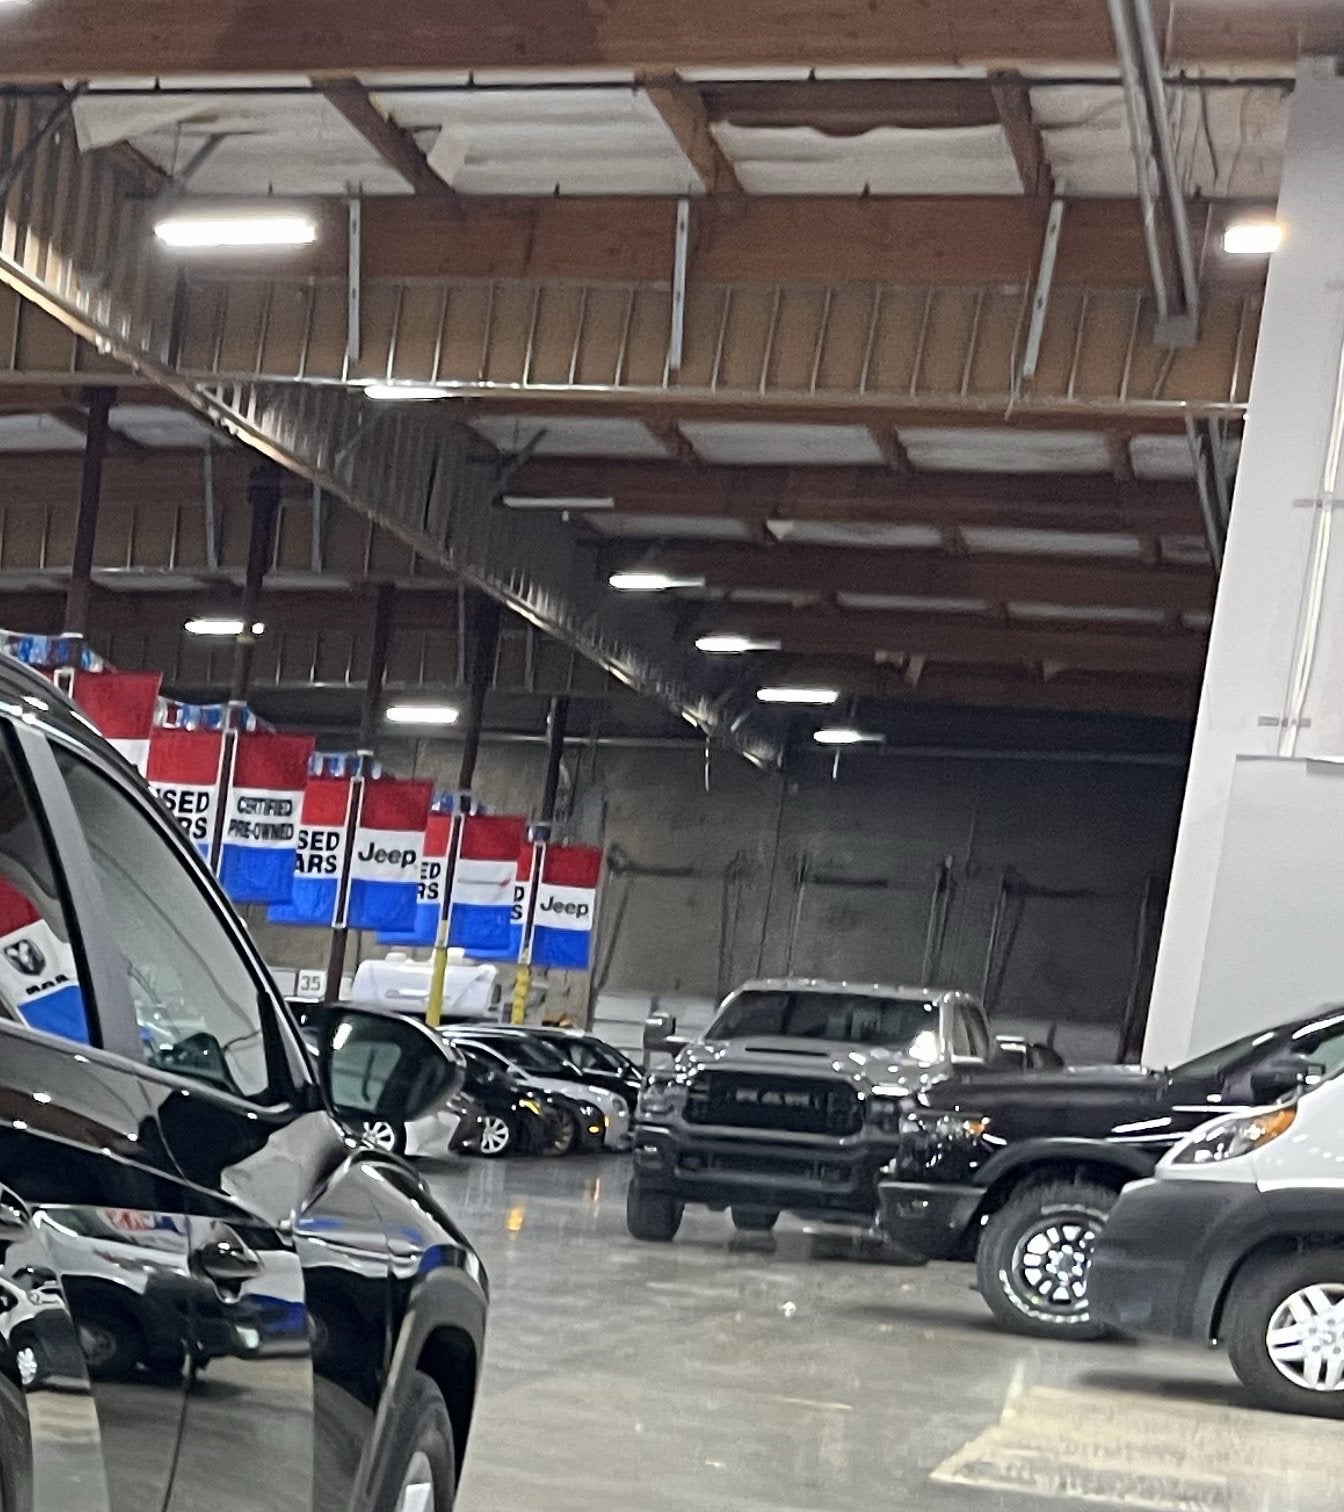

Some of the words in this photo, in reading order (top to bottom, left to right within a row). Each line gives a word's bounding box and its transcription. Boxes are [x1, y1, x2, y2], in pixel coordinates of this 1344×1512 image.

[163, 789, 209, 814] SED
[237, 796, 293, 817] CERTIFIED
[228, 819, 294, 841] PRE-OWNED
[298, 830, 340, 851] SED
[296, 853, 337, 874] ARS
[358, 842, 416, 869] Jeep
[421, 862, 441, 880] ED
[540, 896, 589, 918] Jeep
[301, 975, 321, 991] 35
